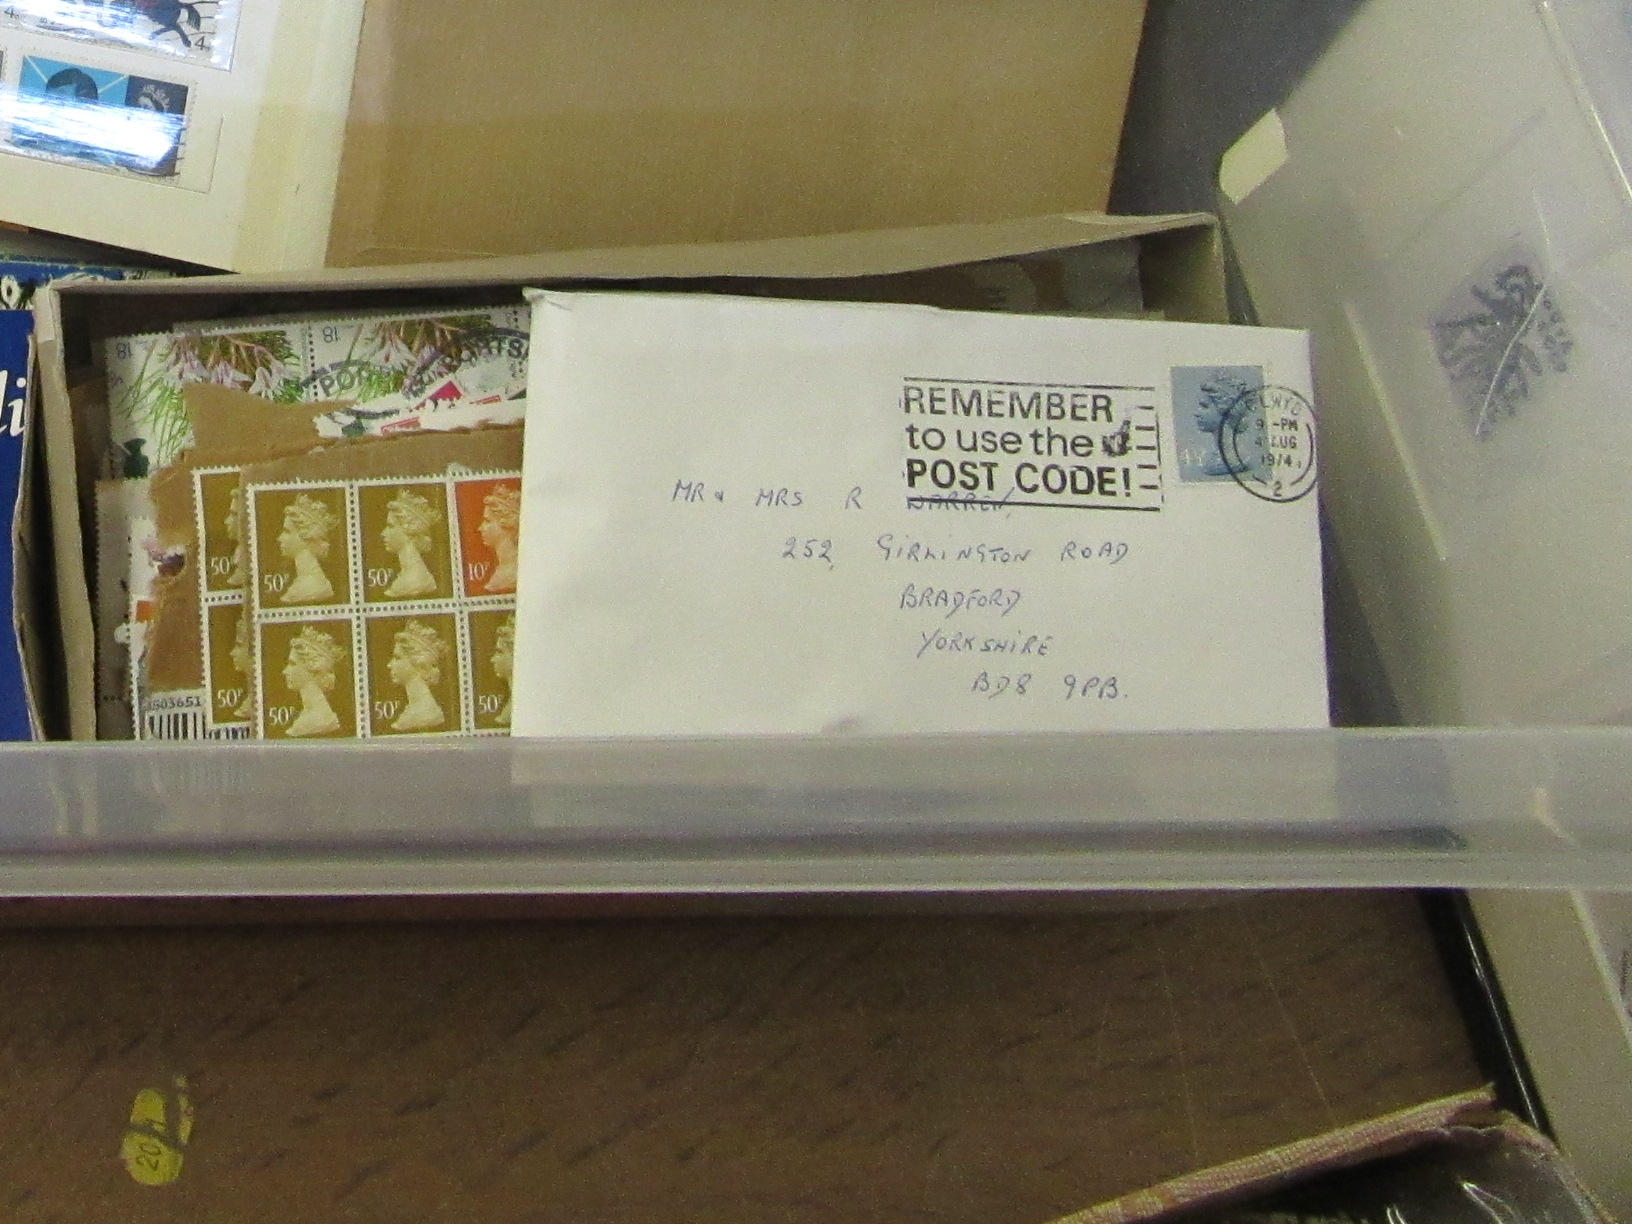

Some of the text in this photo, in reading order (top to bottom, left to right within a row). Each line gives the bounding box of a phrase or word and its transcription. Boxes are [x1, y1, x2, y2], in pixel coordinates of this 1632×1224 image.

[902, 385, 1114, 424] REMEMBER
[905, 424, 1095, 458] to use the
[672, 478, 705, 503] MR
[755, 486, 805, 508] MRS
[844, 487, 863, 511] R
[905, 458, 1133, 498] POST CODE!
[875, 533, 1032, 564] GIRLINGTON
[1059, 540, 1130, 564] ROAD
[899, 583, 1022, 619] BRADFORD
[970, 671, 1033, 701] BD8
